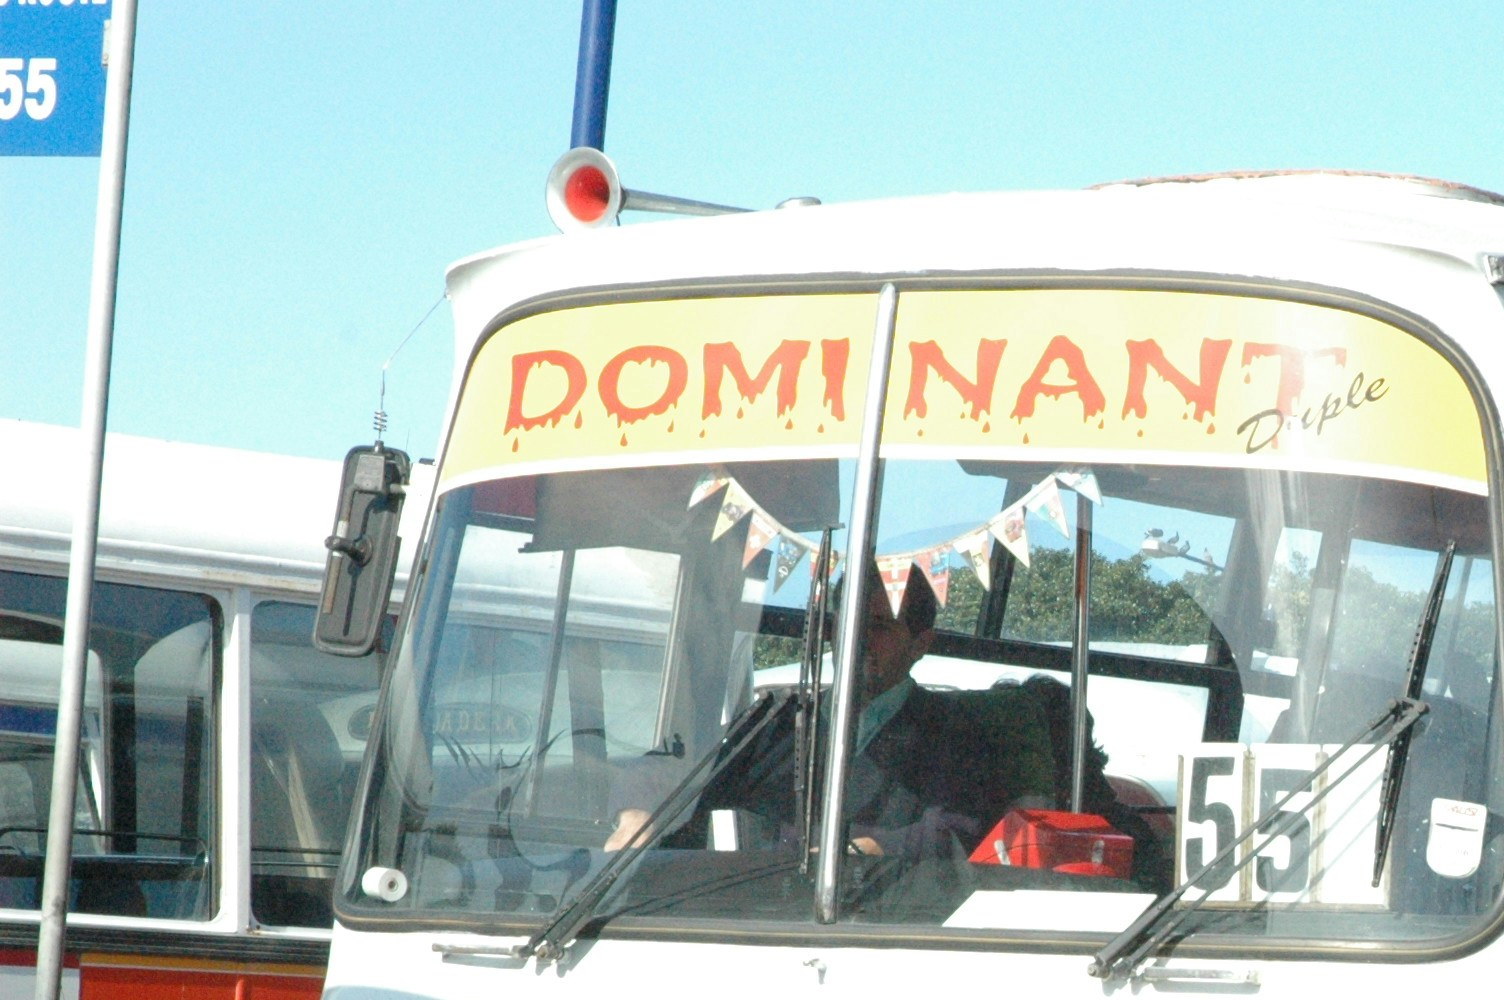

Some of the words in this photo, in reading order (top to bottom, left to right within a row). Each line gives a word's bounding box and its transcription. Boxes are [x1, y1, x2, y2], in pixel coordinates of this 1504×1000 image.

[504, 335, 1347, 448] DOMINANT
[1237, 372, 1390, 455] Duple
[1185, 756, 1313, 892] 55
